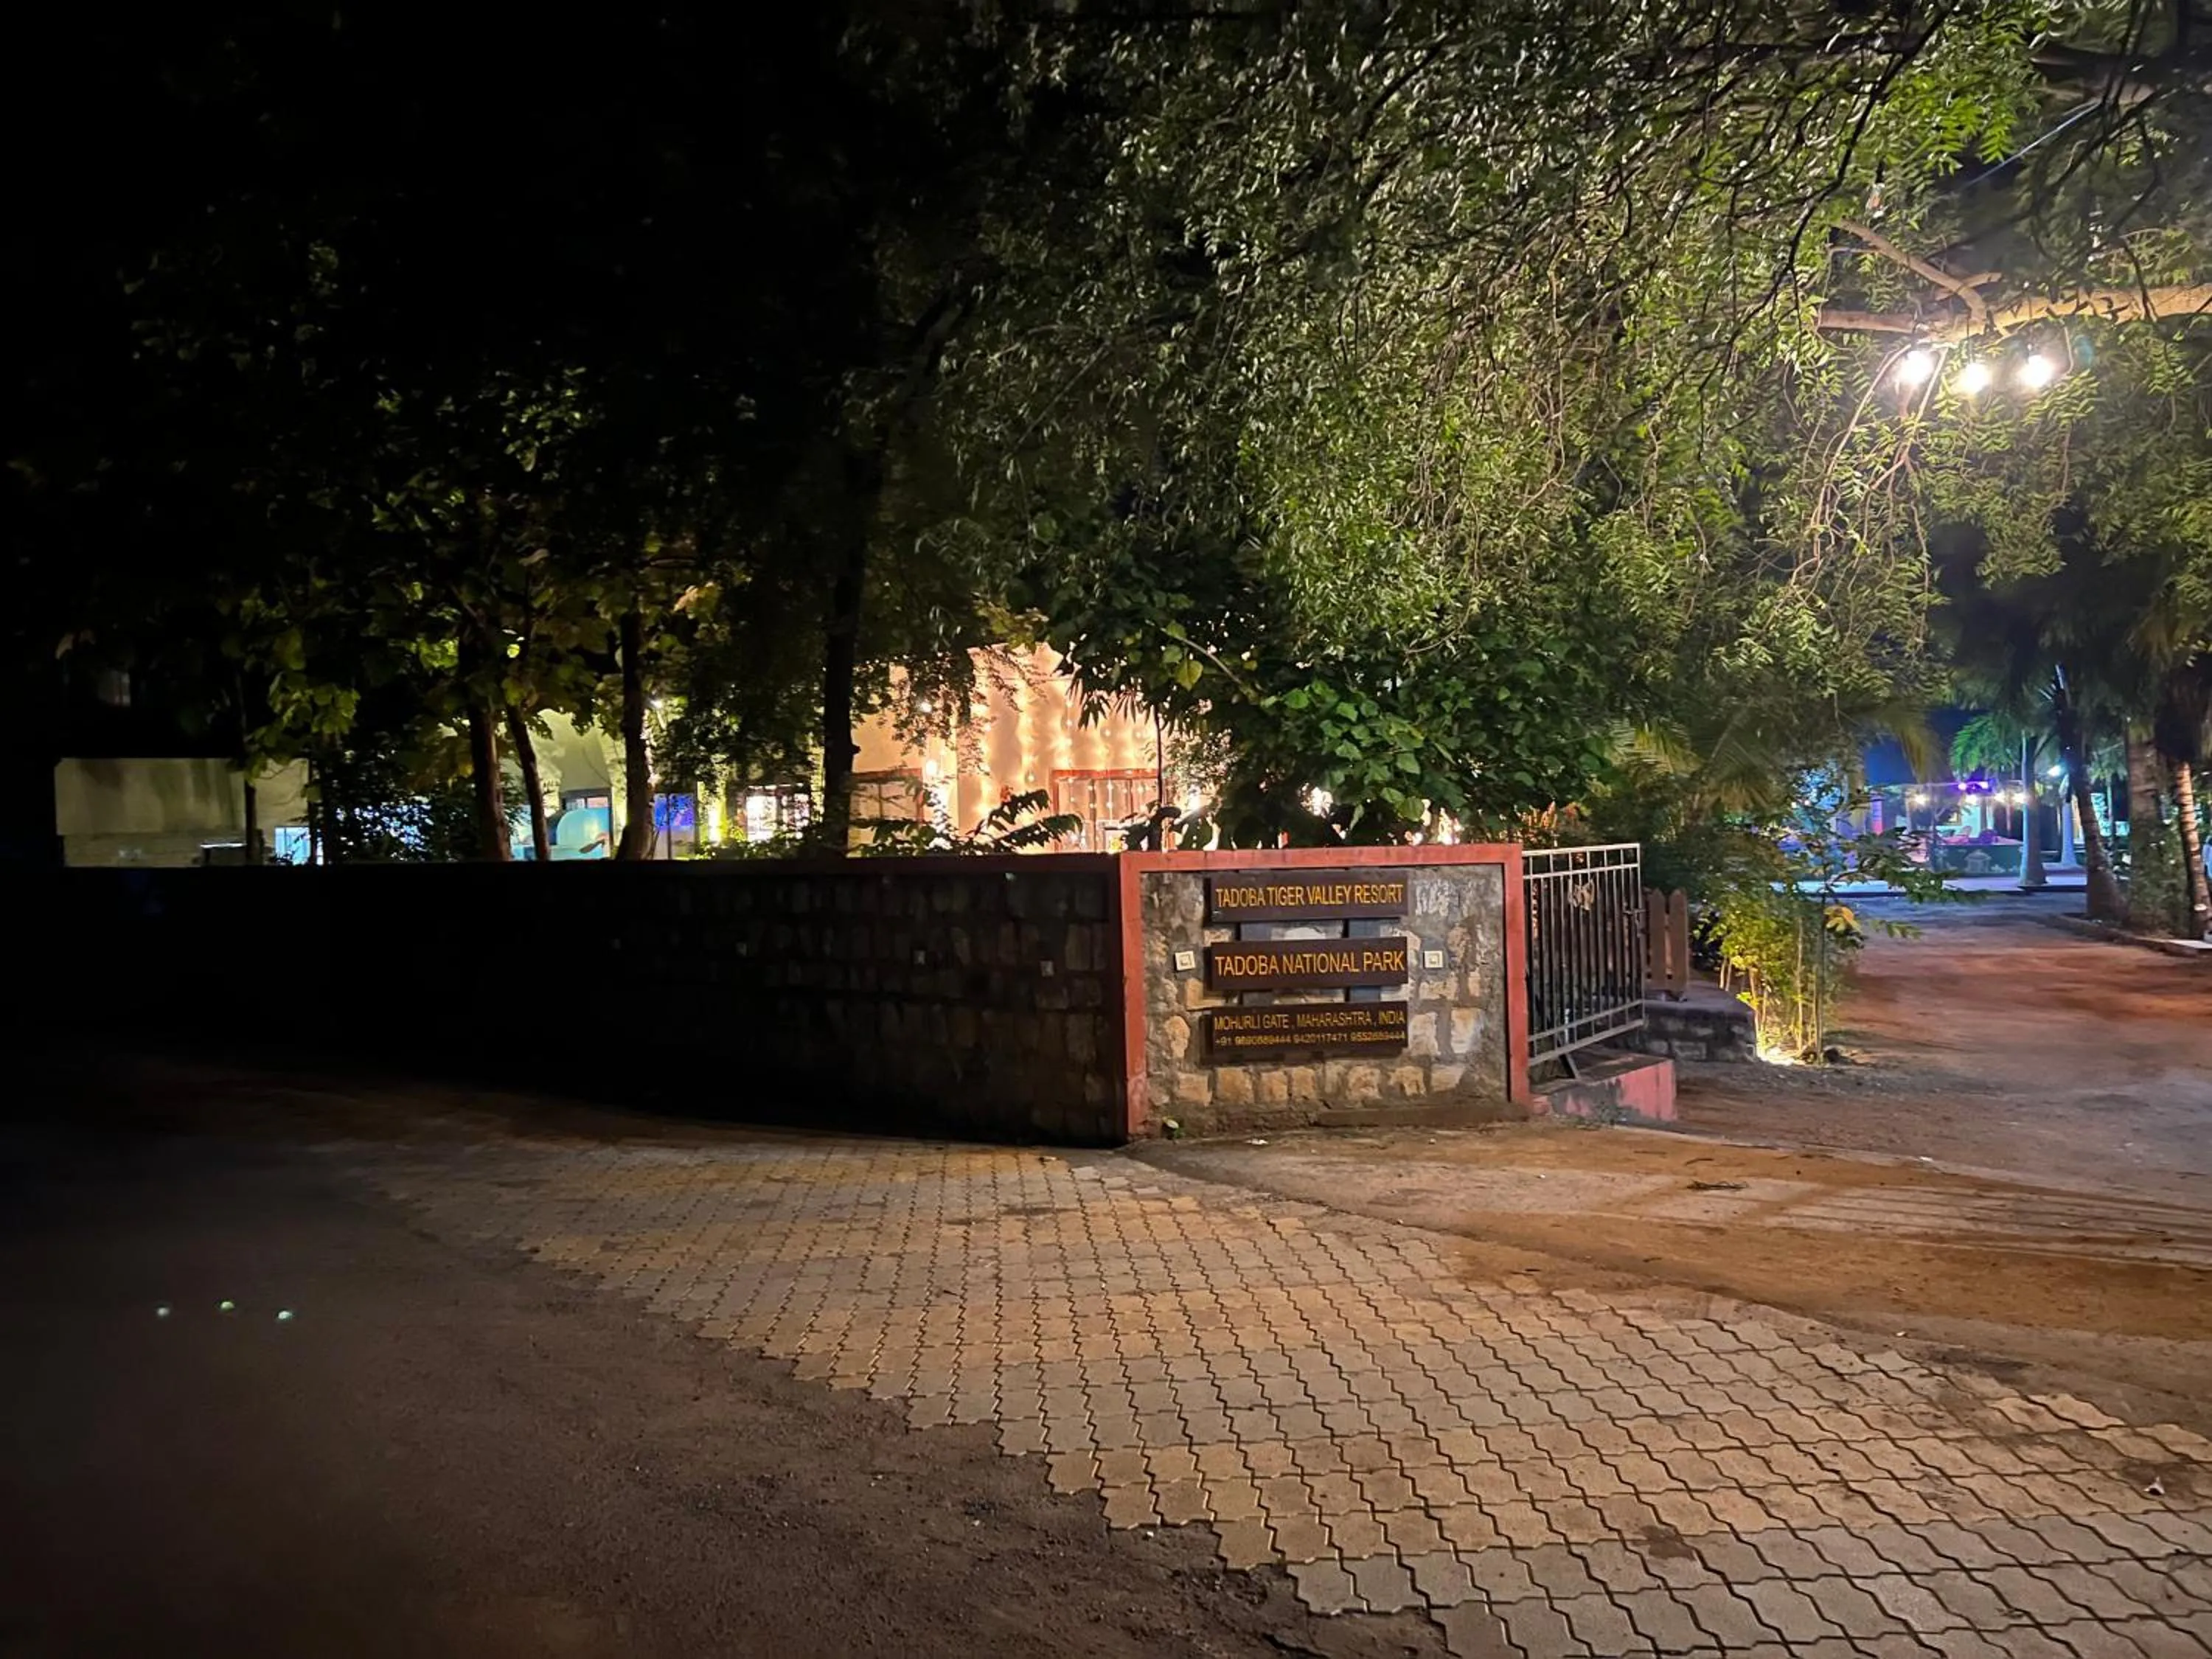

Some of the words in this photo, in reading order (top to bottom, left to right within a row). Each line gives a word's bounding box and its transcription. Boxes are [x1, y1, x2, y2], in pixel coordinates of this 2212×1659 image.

[1215, 887, 1265, 907] TADOBA
[1266, 886, 1305, 906] TIGER
[1307, 884, 1352, 905] VALLEY
[1354, 883, 1404, 905] RESORT
[1214, 955, 1279, 976] TADOBA
[1282, 952, 1360, 974] NATIONAL
[1363, 950, 1405, 973] PARK
[1214, 1015, 1260, 1031] MOHURLI
[1379, 1010, 1405, 1025] INDIA
